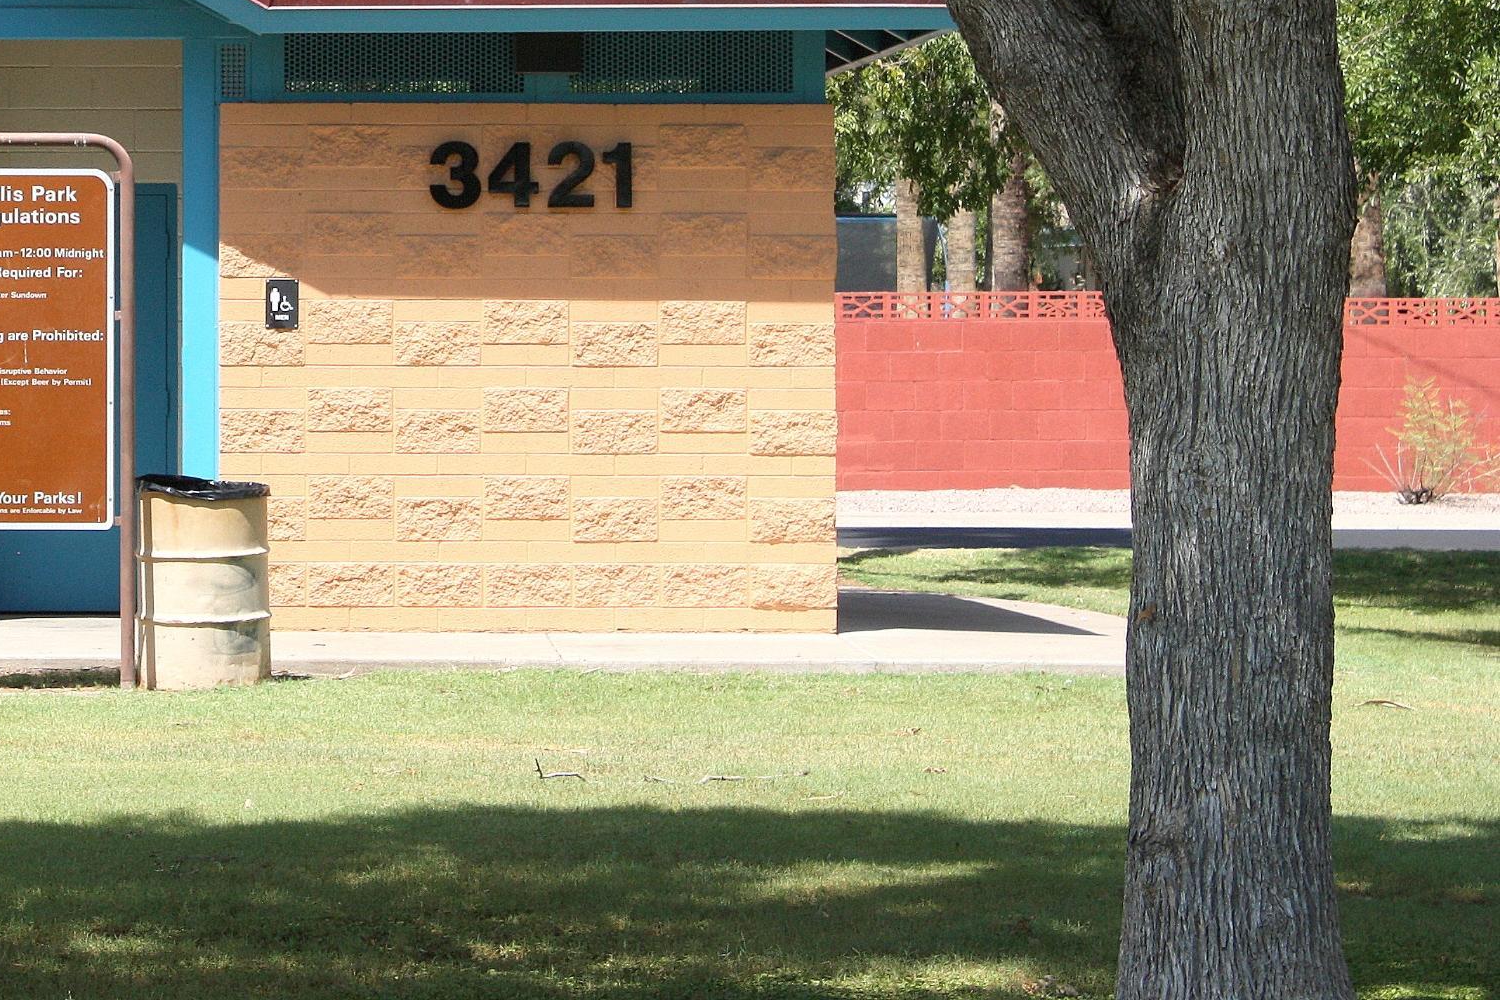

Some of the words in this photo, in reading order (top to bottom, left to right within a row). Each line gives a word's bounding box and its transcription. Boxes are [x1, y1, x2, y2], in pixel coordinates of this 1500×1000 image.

[429, 140, 633, 209] 3421
[31, 186, 78, 202] Park
[54, 248, 104, 260] Midnight
[56, 267, 83, 278] For:
[7, 332, 29, 341] are
[32, 329, 105, 341] Prohibited:
[51, 379, 62, 387] by
[33, 492, 82, 504] Parks!
